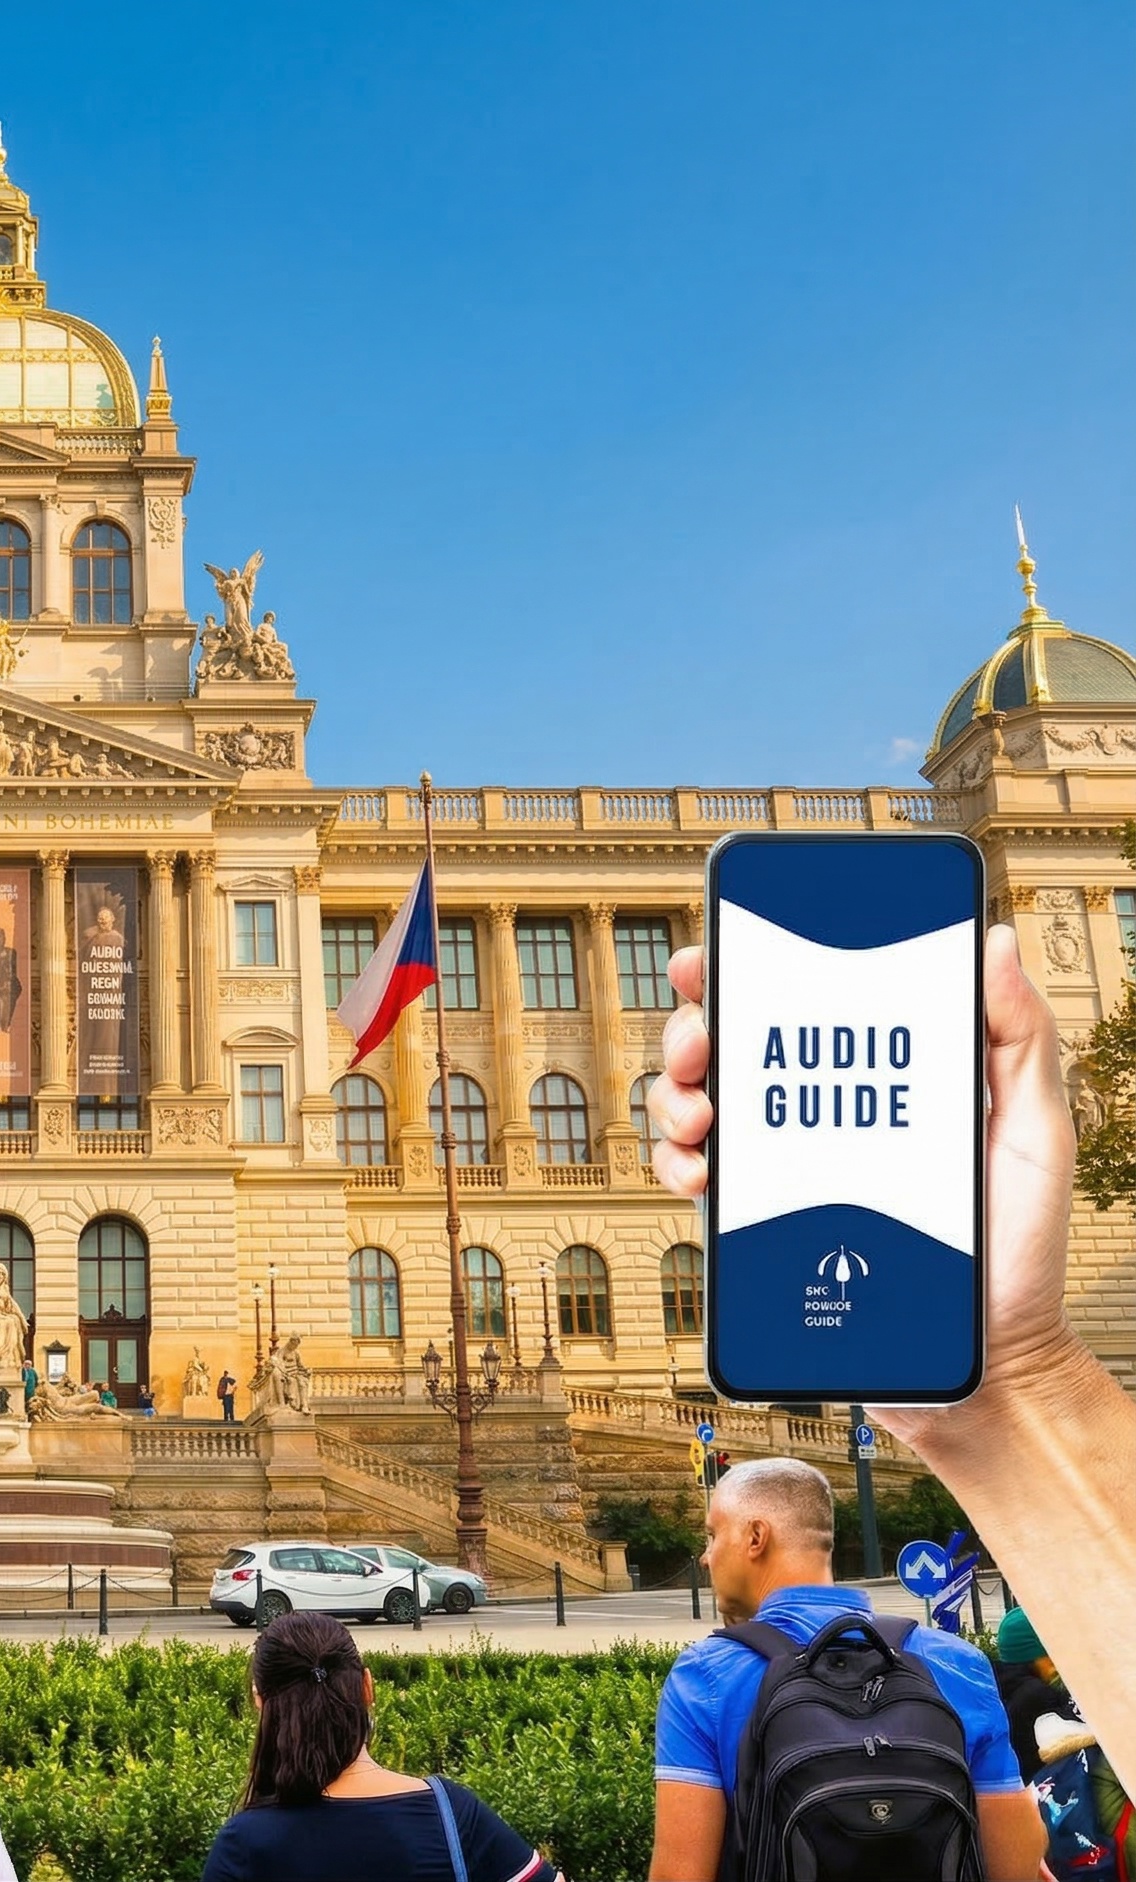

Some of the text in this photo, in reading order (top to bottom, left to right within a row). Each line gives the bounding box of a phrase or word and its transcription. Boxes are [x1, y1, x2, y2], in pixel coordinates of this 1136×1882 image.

[45, 813, 174, 830] BOHEMIAE
[763, 1026, 911, 1069] AUDIO
[765, 1084, 910, 1128] GUIDE
[804, 1316, 843, 1327] GUIDE
[861, 1427, 870, 1442] P
